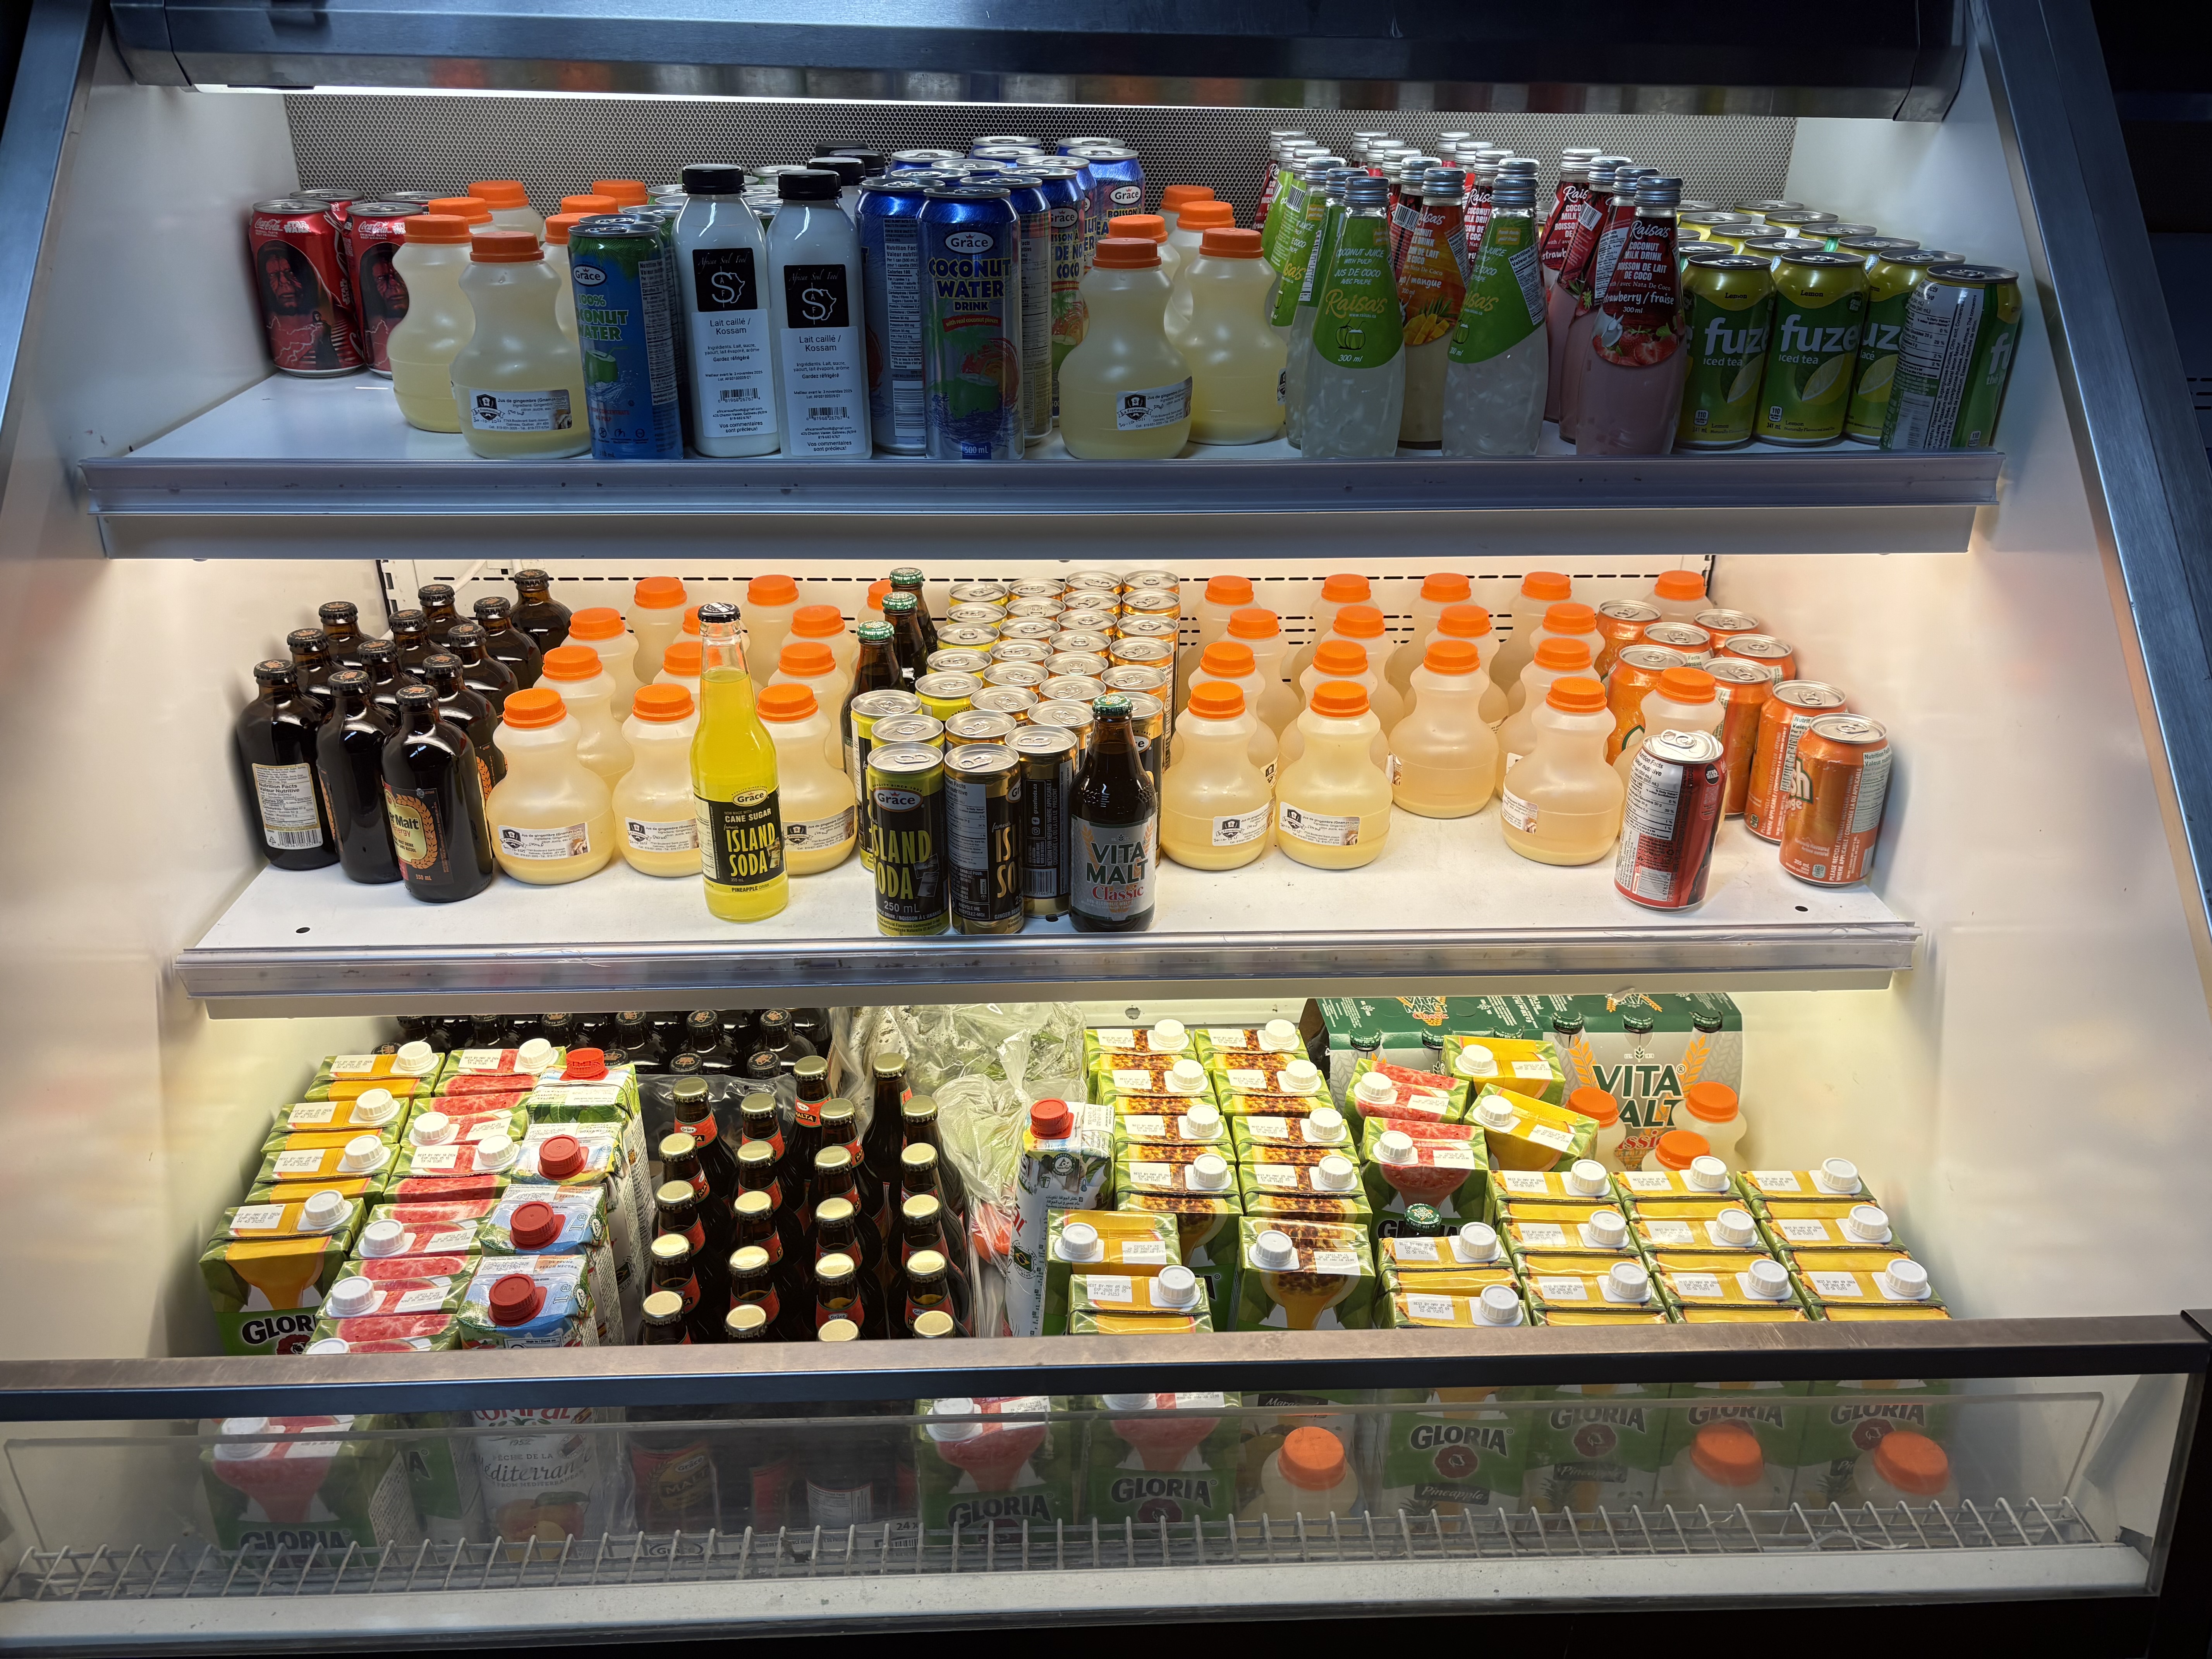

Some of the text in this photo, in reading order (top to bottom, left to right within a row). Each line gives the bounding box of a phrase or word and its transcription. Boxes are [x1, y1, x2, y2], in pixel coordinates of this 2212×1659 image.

[1115, 191, 1139, 200] Grace
[1107, 208, 1137, 218] BOISSON
[1630, 220, 1671, 240] Raisa's
[951, 238, 988, 247] Grace
[1629, 242, 1659, 251] COCONUT
[1055, 246, 1068, 261] DE
[1336, 248, 1384, 258] COCONUT JUICE
[1425, 248, 1439, 259] LAIT
[1624, 251, 1662, 261] MILK DRINK
[928, 257, 1012, 278] COCONUT
[1056, 262, 1079, 279] COCO
[1334, 268, 1381, 277] JUS DE COCO
[1617, 262, 1667, 273] BOISSON DE LAIT
[575, 271, 601, 280] Grace
[1624, 271, 1652, 280] DE COCO
[936, 279, 1005, 299] WATER
[1411, 276, 1442, 289] mangue
[578, 294, 606, 307] 100%
[1326, 289, 1388, 319] Raisa's
[1650, 291, 1674, 305] fraise
[954, 300, 990, 312] DRINK
[1780, 314, 1858, 352] fuze
[1703, 357, 1743, 366] iced tea
[1779, 354, 1819, 364] iced tea
[978, 446, 989, 454] mL
[737, 792, 764, 802] Grace
[877, 793, 916, 805] Grace
[749, 808, 771, 821] SUGAR
[395, 814, 419, 830] Malt
[726, 823, 776, 852] ISLAND
[873, 824, 932, 864] SLAND
[1091, 841, 1146, 864] VITA
[1832, 844, 1841, 864] RECYCLE
[1839, 838, 1849, 865] APPLICABLE
[729, 850, 768, 877] SODA
[1086, 859, 1148, 885] MALT
[1092, 884, 1144, 901] Classic
[884, 900, 920, 913] 250 mL
[958, 902, 974, 911] RECYCLE
[994, 911, 1011, 920] GINGER
[1403, 1004, 1448, 1013] MALT
[1592, 1064, 1684, 1099] VITA
[1618, 1099, 1686, 1129] ALT
[1551, 1408, 1646, 1434] GLORIA
[1410, 1424, 1508, 1457] GLORIA
[1111, 1477, 1212, 1509] GLORIA
[1421, 1486, 1484, 1501] Pineapple
[948, 1494, 1052, 1530] GLORIA
